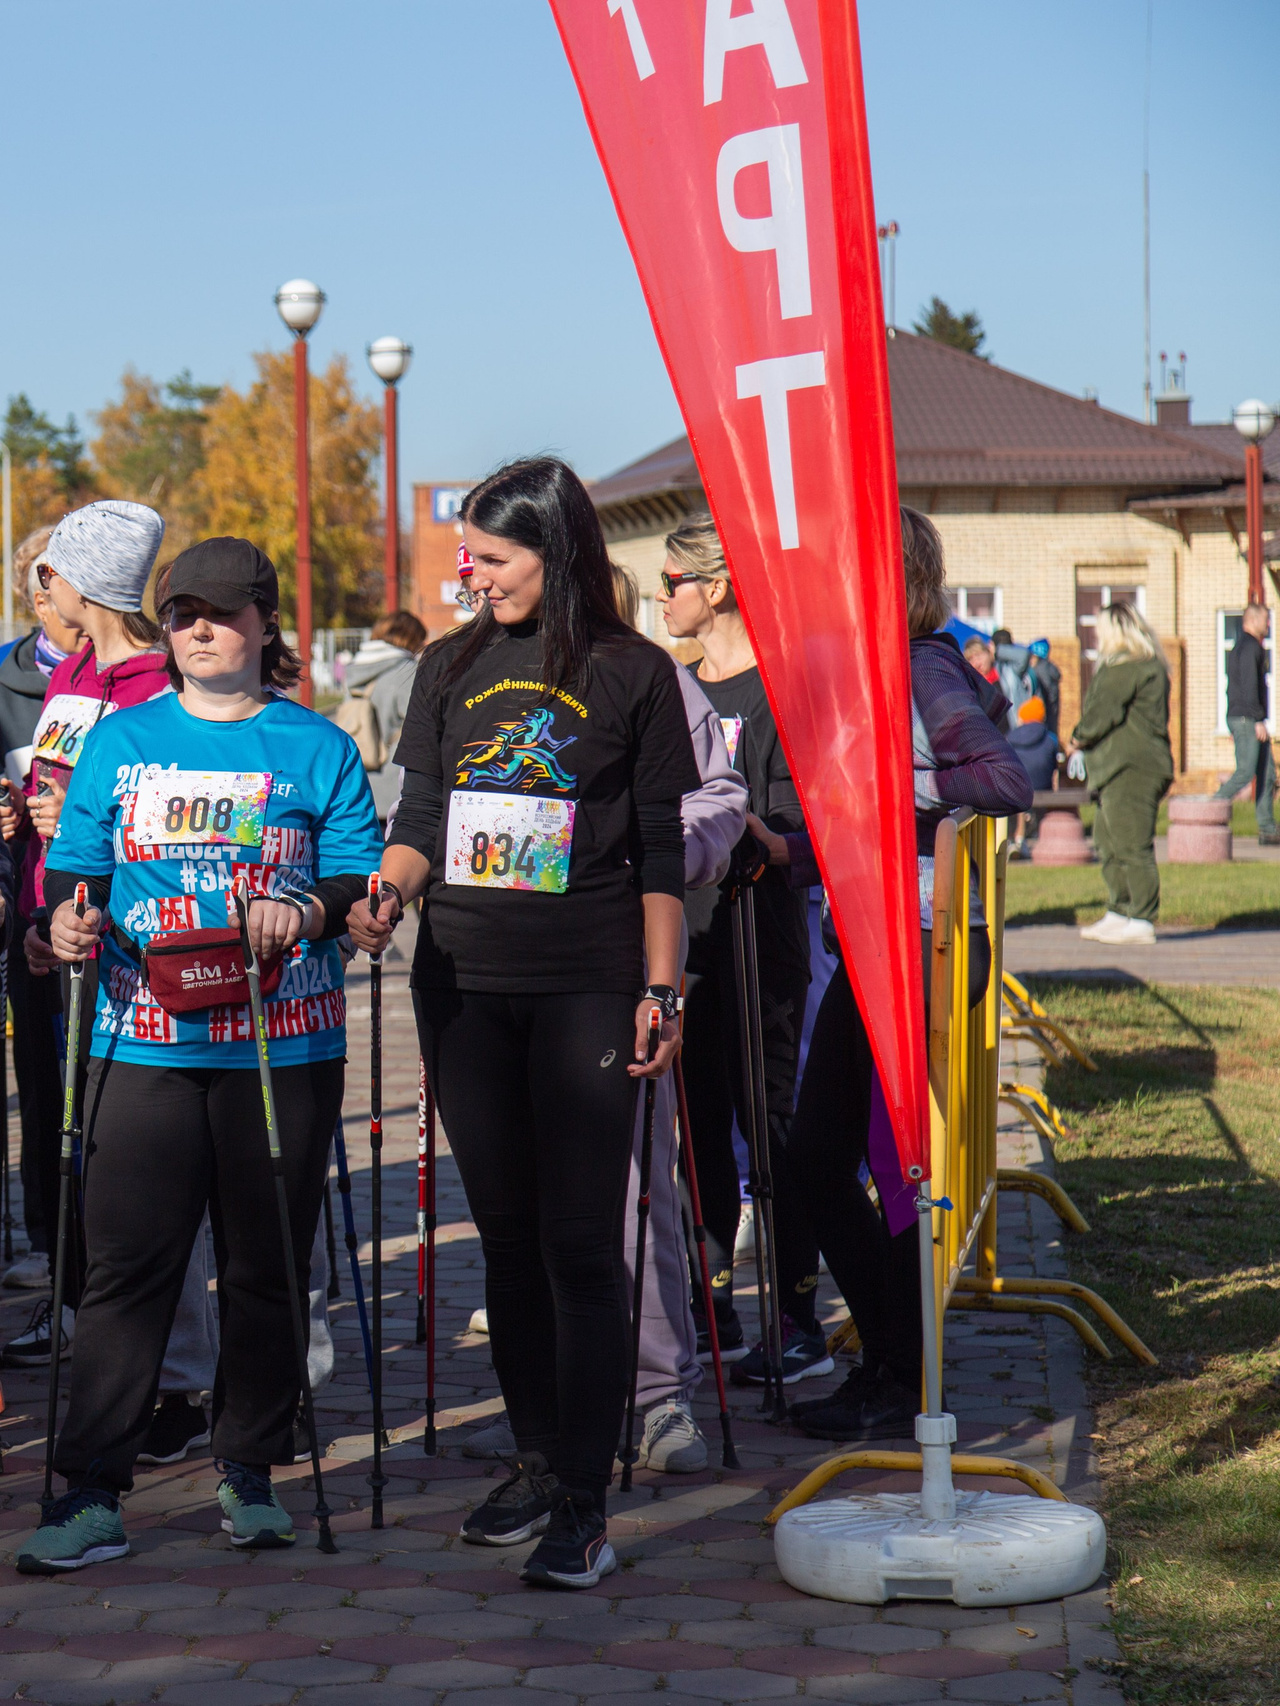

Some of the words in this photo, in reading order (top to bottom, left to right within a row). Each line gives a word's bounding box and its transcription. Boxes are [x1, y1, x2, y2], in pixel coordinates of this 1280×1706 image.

[465, 678, 547, 709] Рождённые
[38, 720, 83, 754] 816
[164, 796, 234, 833] 808
[471, 831, 536, 878] 834
[182, 977, 223, 990] ЦВЕТОЧНЫЙ
[225, 975, 244, 985] ЗАБЕГ
[257, 1015, 269, 1061] LEKI
[261, 1085, 273, 1130] SPIN
